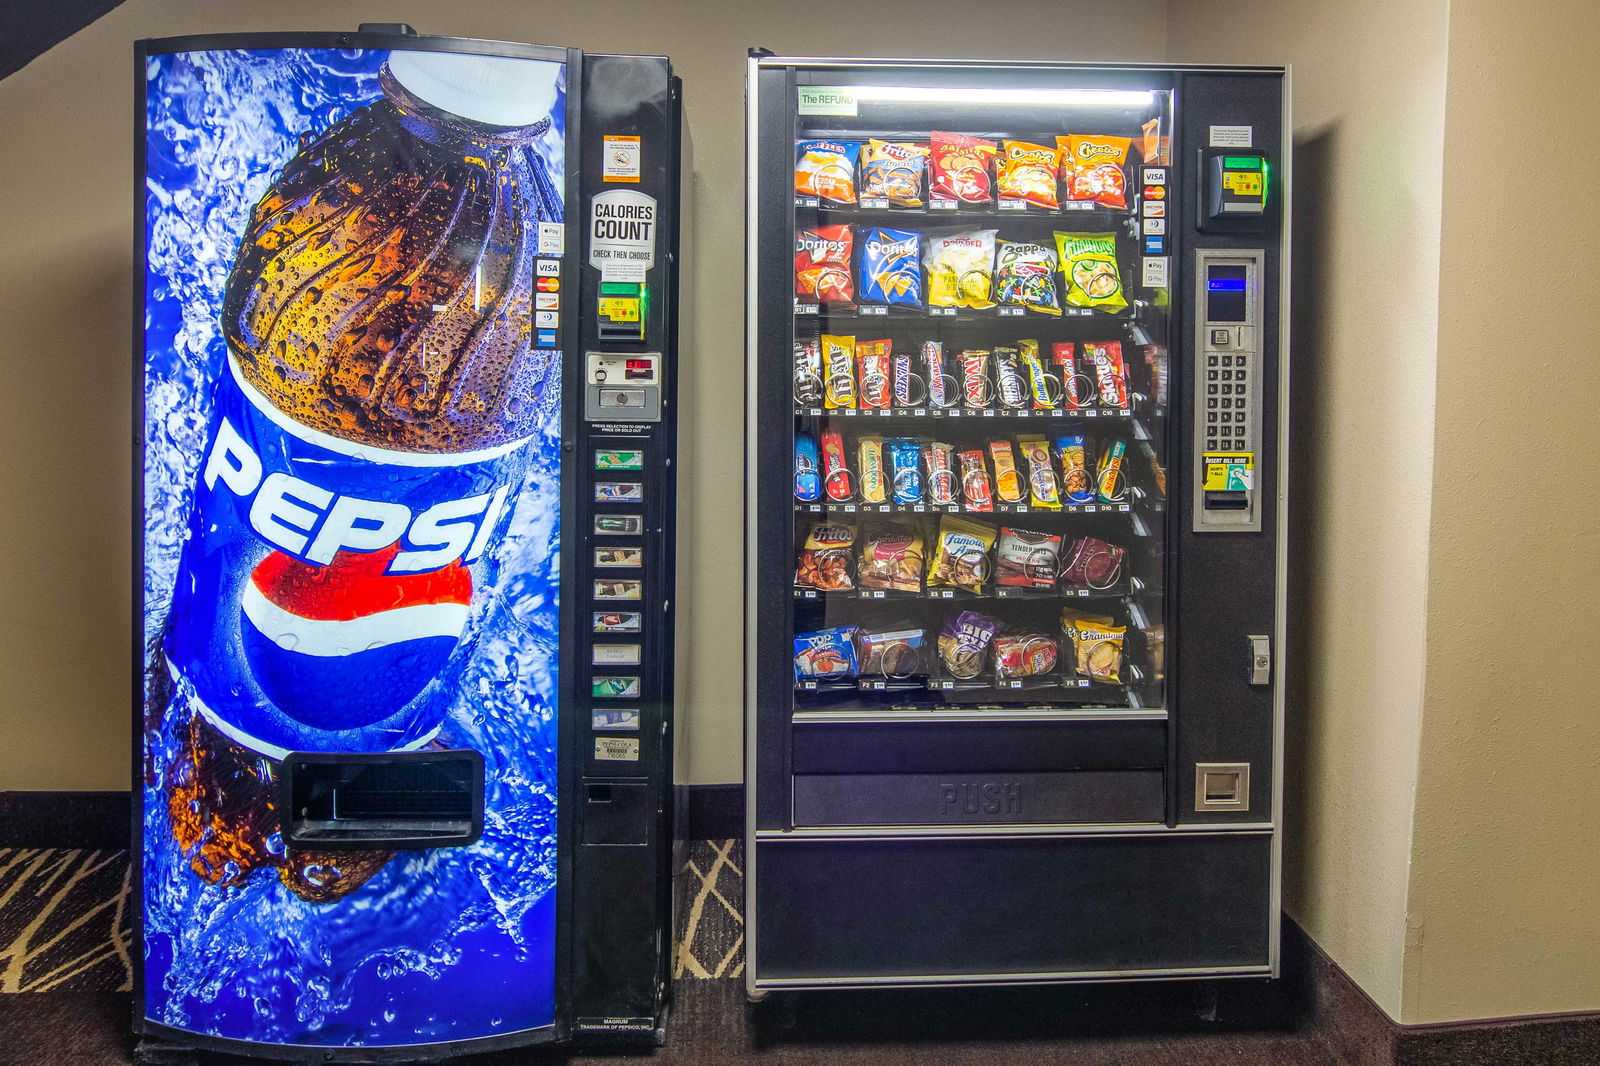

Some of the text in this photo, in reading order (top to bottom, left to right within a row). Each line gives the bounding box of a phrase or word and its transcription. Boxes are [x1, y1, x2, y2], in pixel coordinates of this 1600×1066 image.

[802, 95, 818, 104] The
[1077, 142, 1122, 158] Cheetos
[595, 204, 653, 220] CALORIES
[594, 219, 652, 241] COUNT
[796, 238, 846, 252] Doritos
[870, 240, 919, 258] Doritos
[593, 249, 651, 261] CHECK THEN CHOOSE
[539, 264, 558, 272] VISA
[204, 416, 511, 572] PEPSI
[814, 526, 854, 542] Fritos
[945, 532, 986, 548] Famous
[962, 623, 993, 643] BIG
[940, 783, 1022, 815] PUSH
